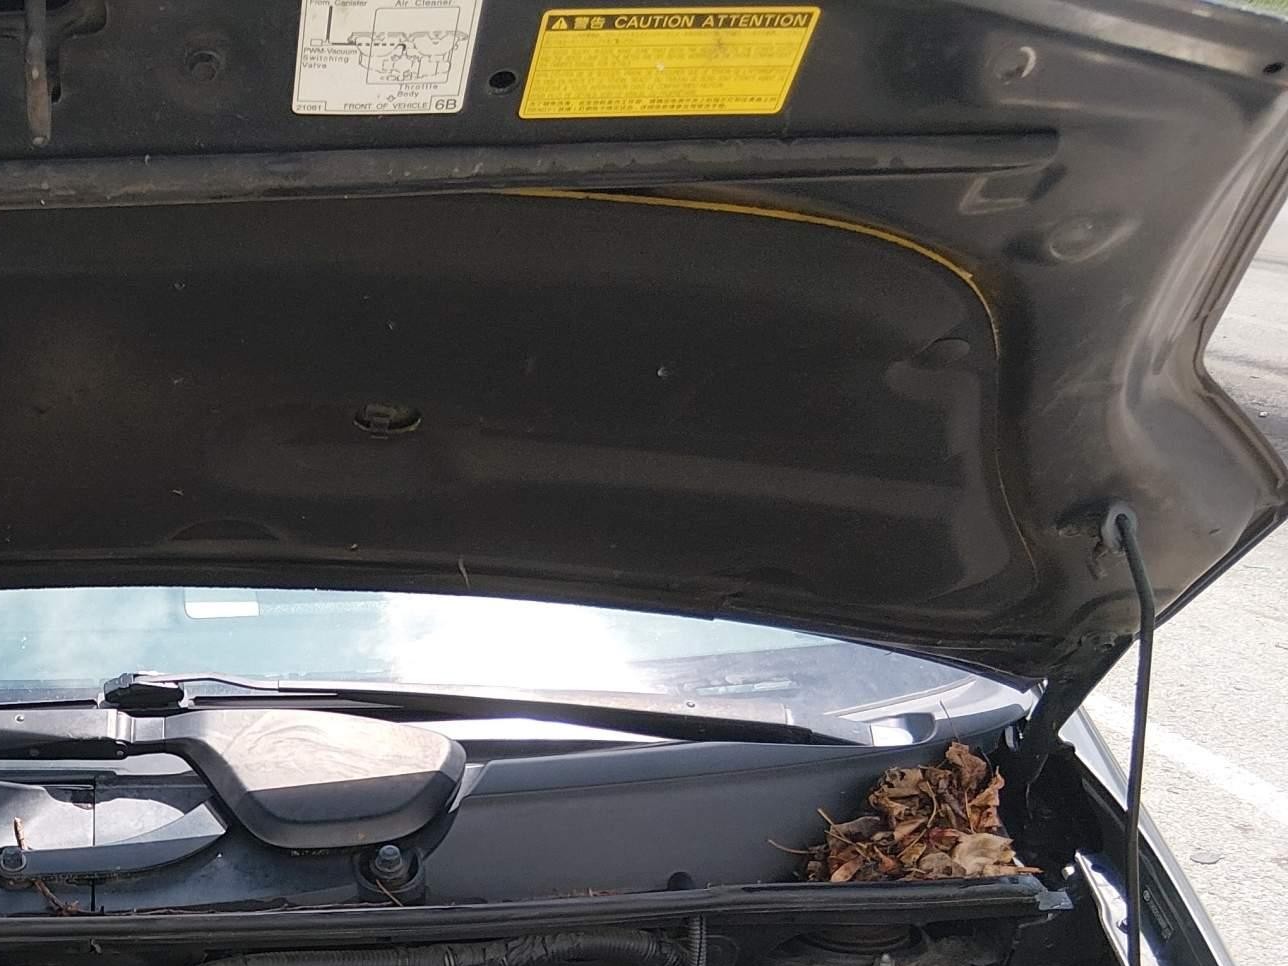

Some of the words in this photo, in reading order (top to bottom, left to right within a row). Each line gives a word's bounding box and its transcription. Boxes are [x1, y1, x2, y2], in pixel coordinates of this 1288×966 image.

[614, 14, 695, 29] CAUTION
[701, 13, 809, 28] ATTENTION
[376, 102, 389, 110] OF
[392, 102, 429, 110] VEHICLE
[435, 98, 457, 111] 6B
